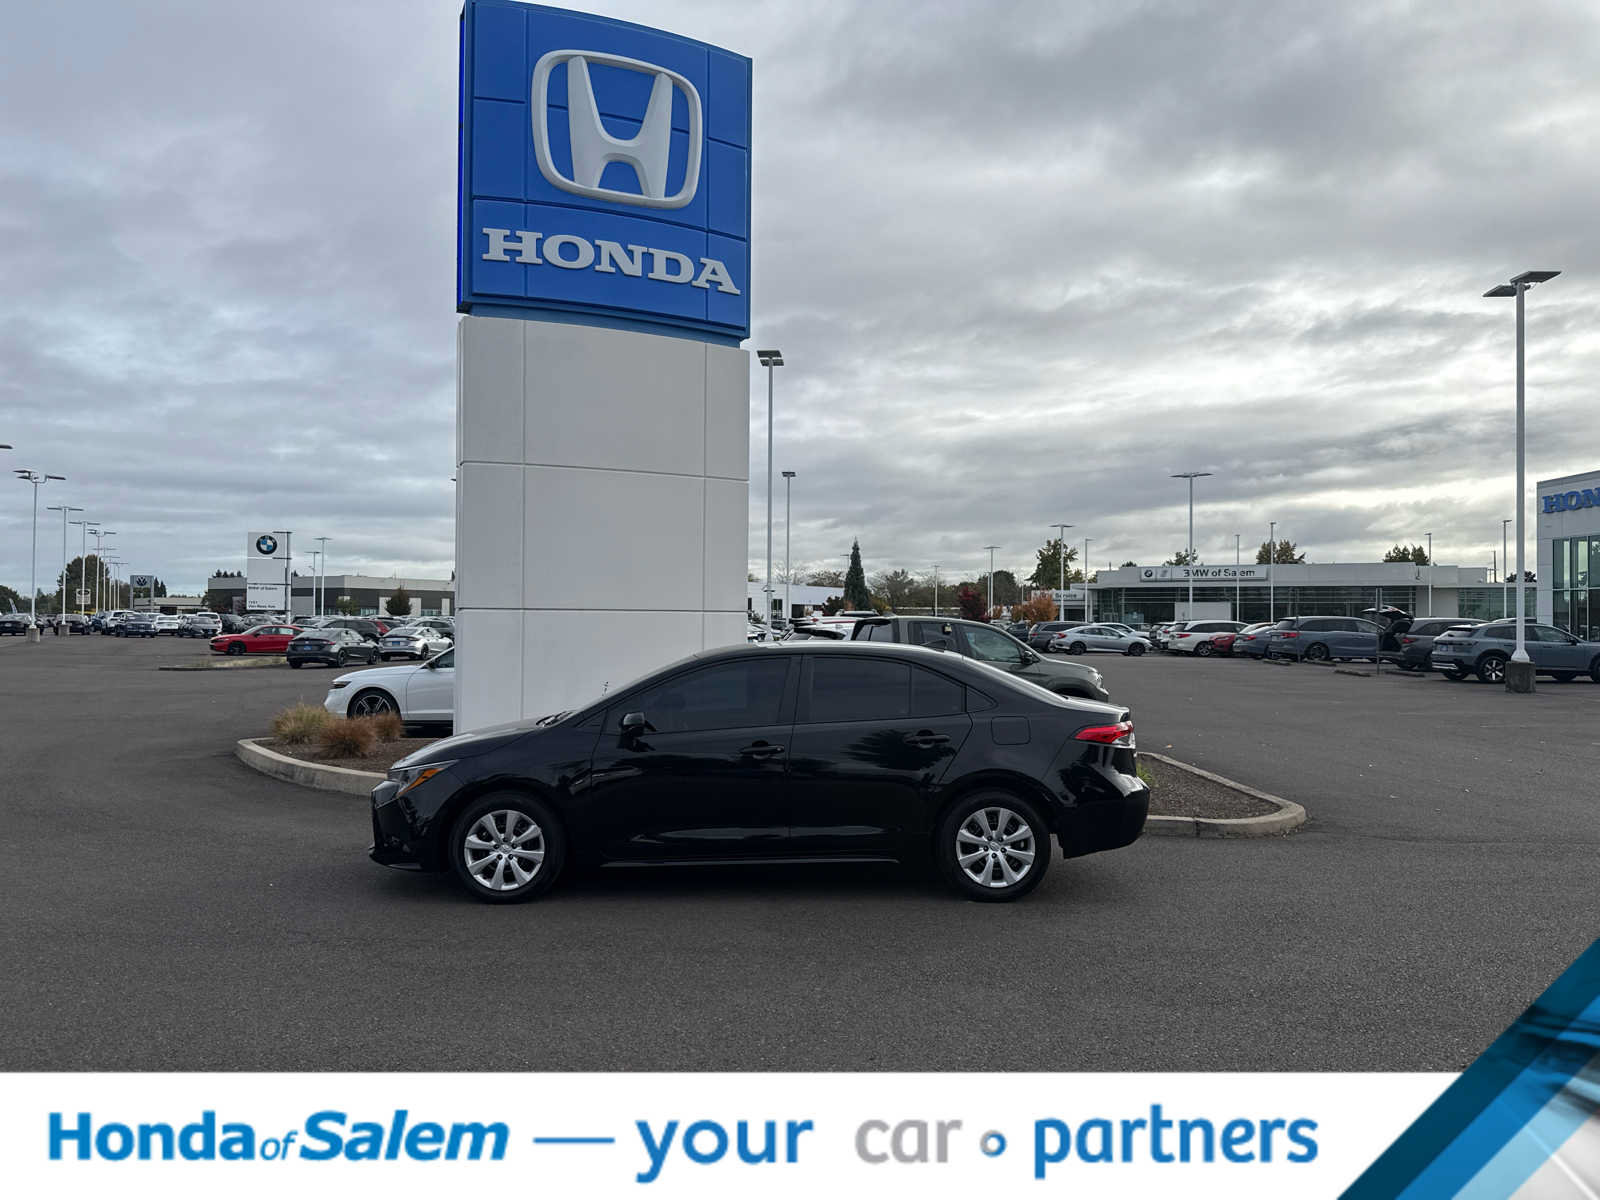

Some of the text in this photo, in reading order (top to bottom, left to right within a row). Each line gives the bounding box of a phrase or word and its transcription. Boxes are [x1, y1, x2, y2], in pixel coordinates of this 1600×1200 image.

[482, 227, 741, 296] HONDA
[1211, 568, 1221, 577] of
[1223, 568, 1255, 577] Saem
